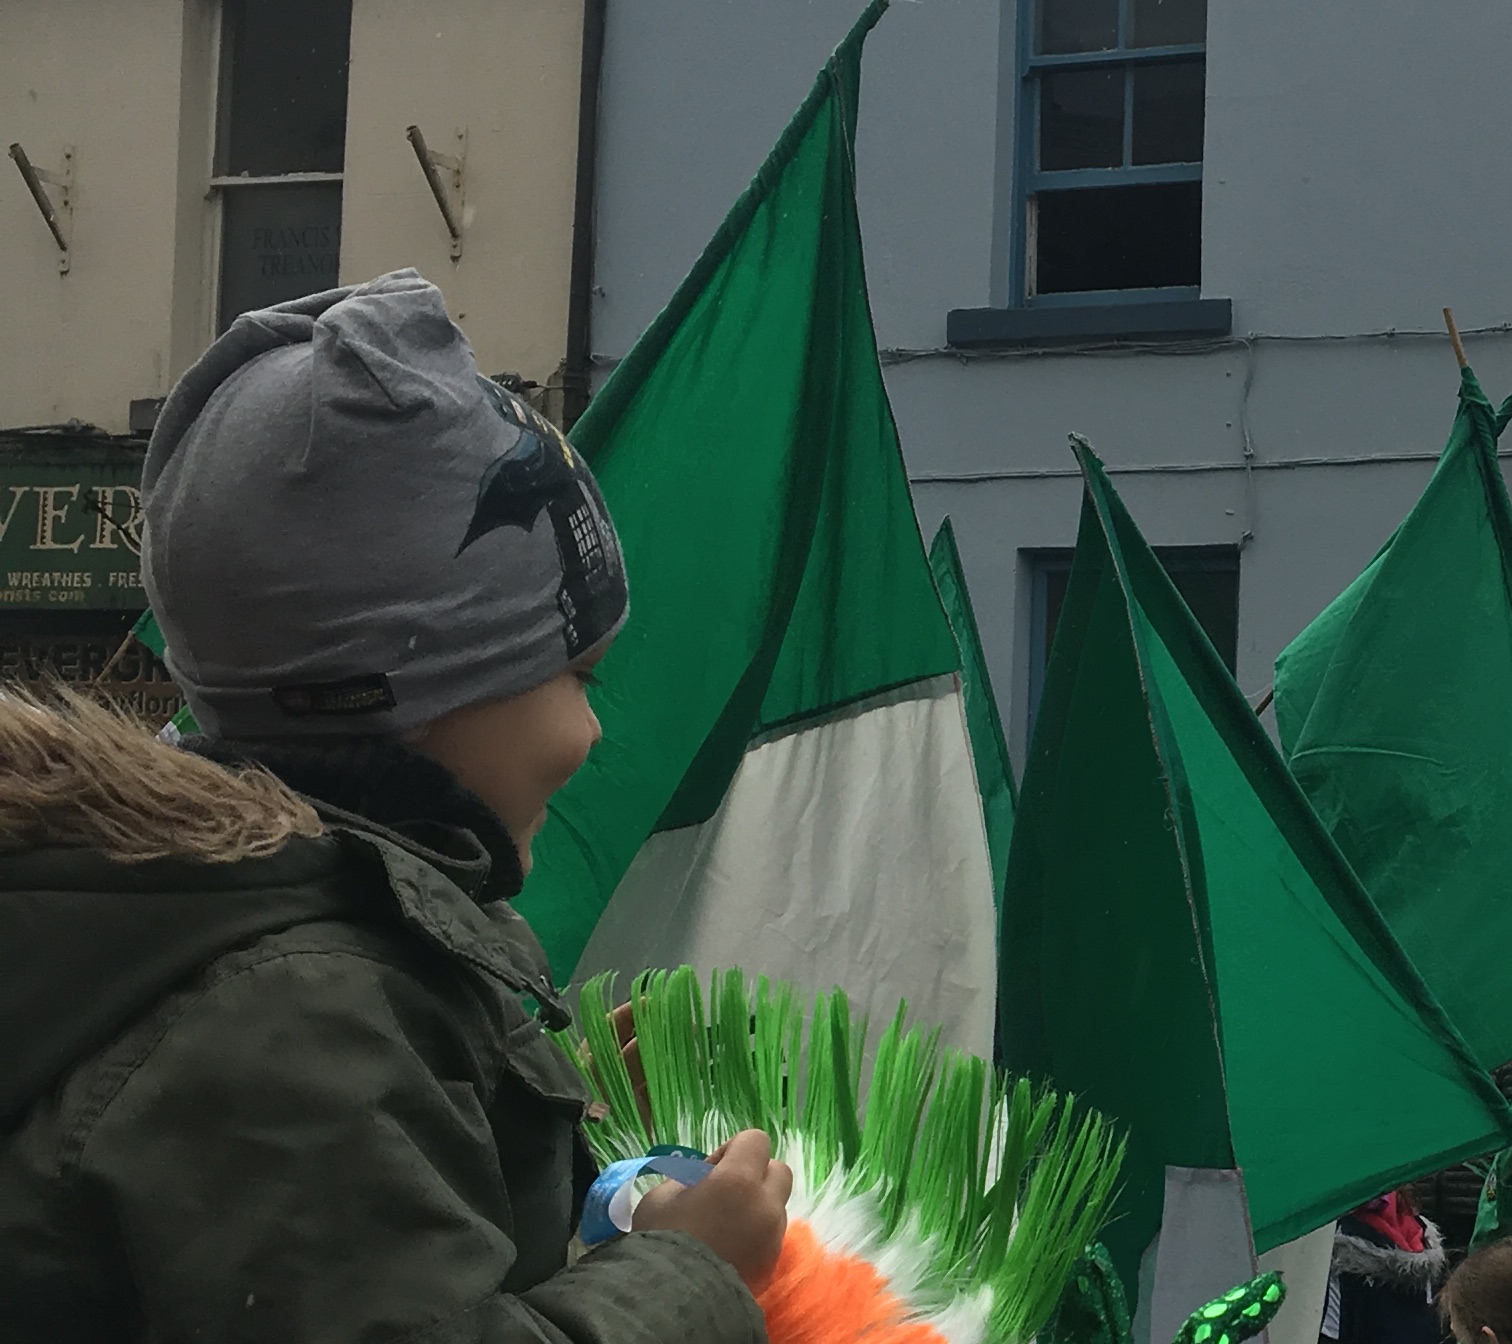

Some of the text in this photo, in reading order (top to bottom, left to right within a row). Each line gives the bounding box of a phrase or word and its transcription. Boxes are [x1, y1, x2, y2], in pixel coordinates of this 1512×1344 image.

[252, 225, 330, 250] FRANCIS
[257, 252, 339, 277] TREANO
[7, 572, 92, 588] WREATHES
